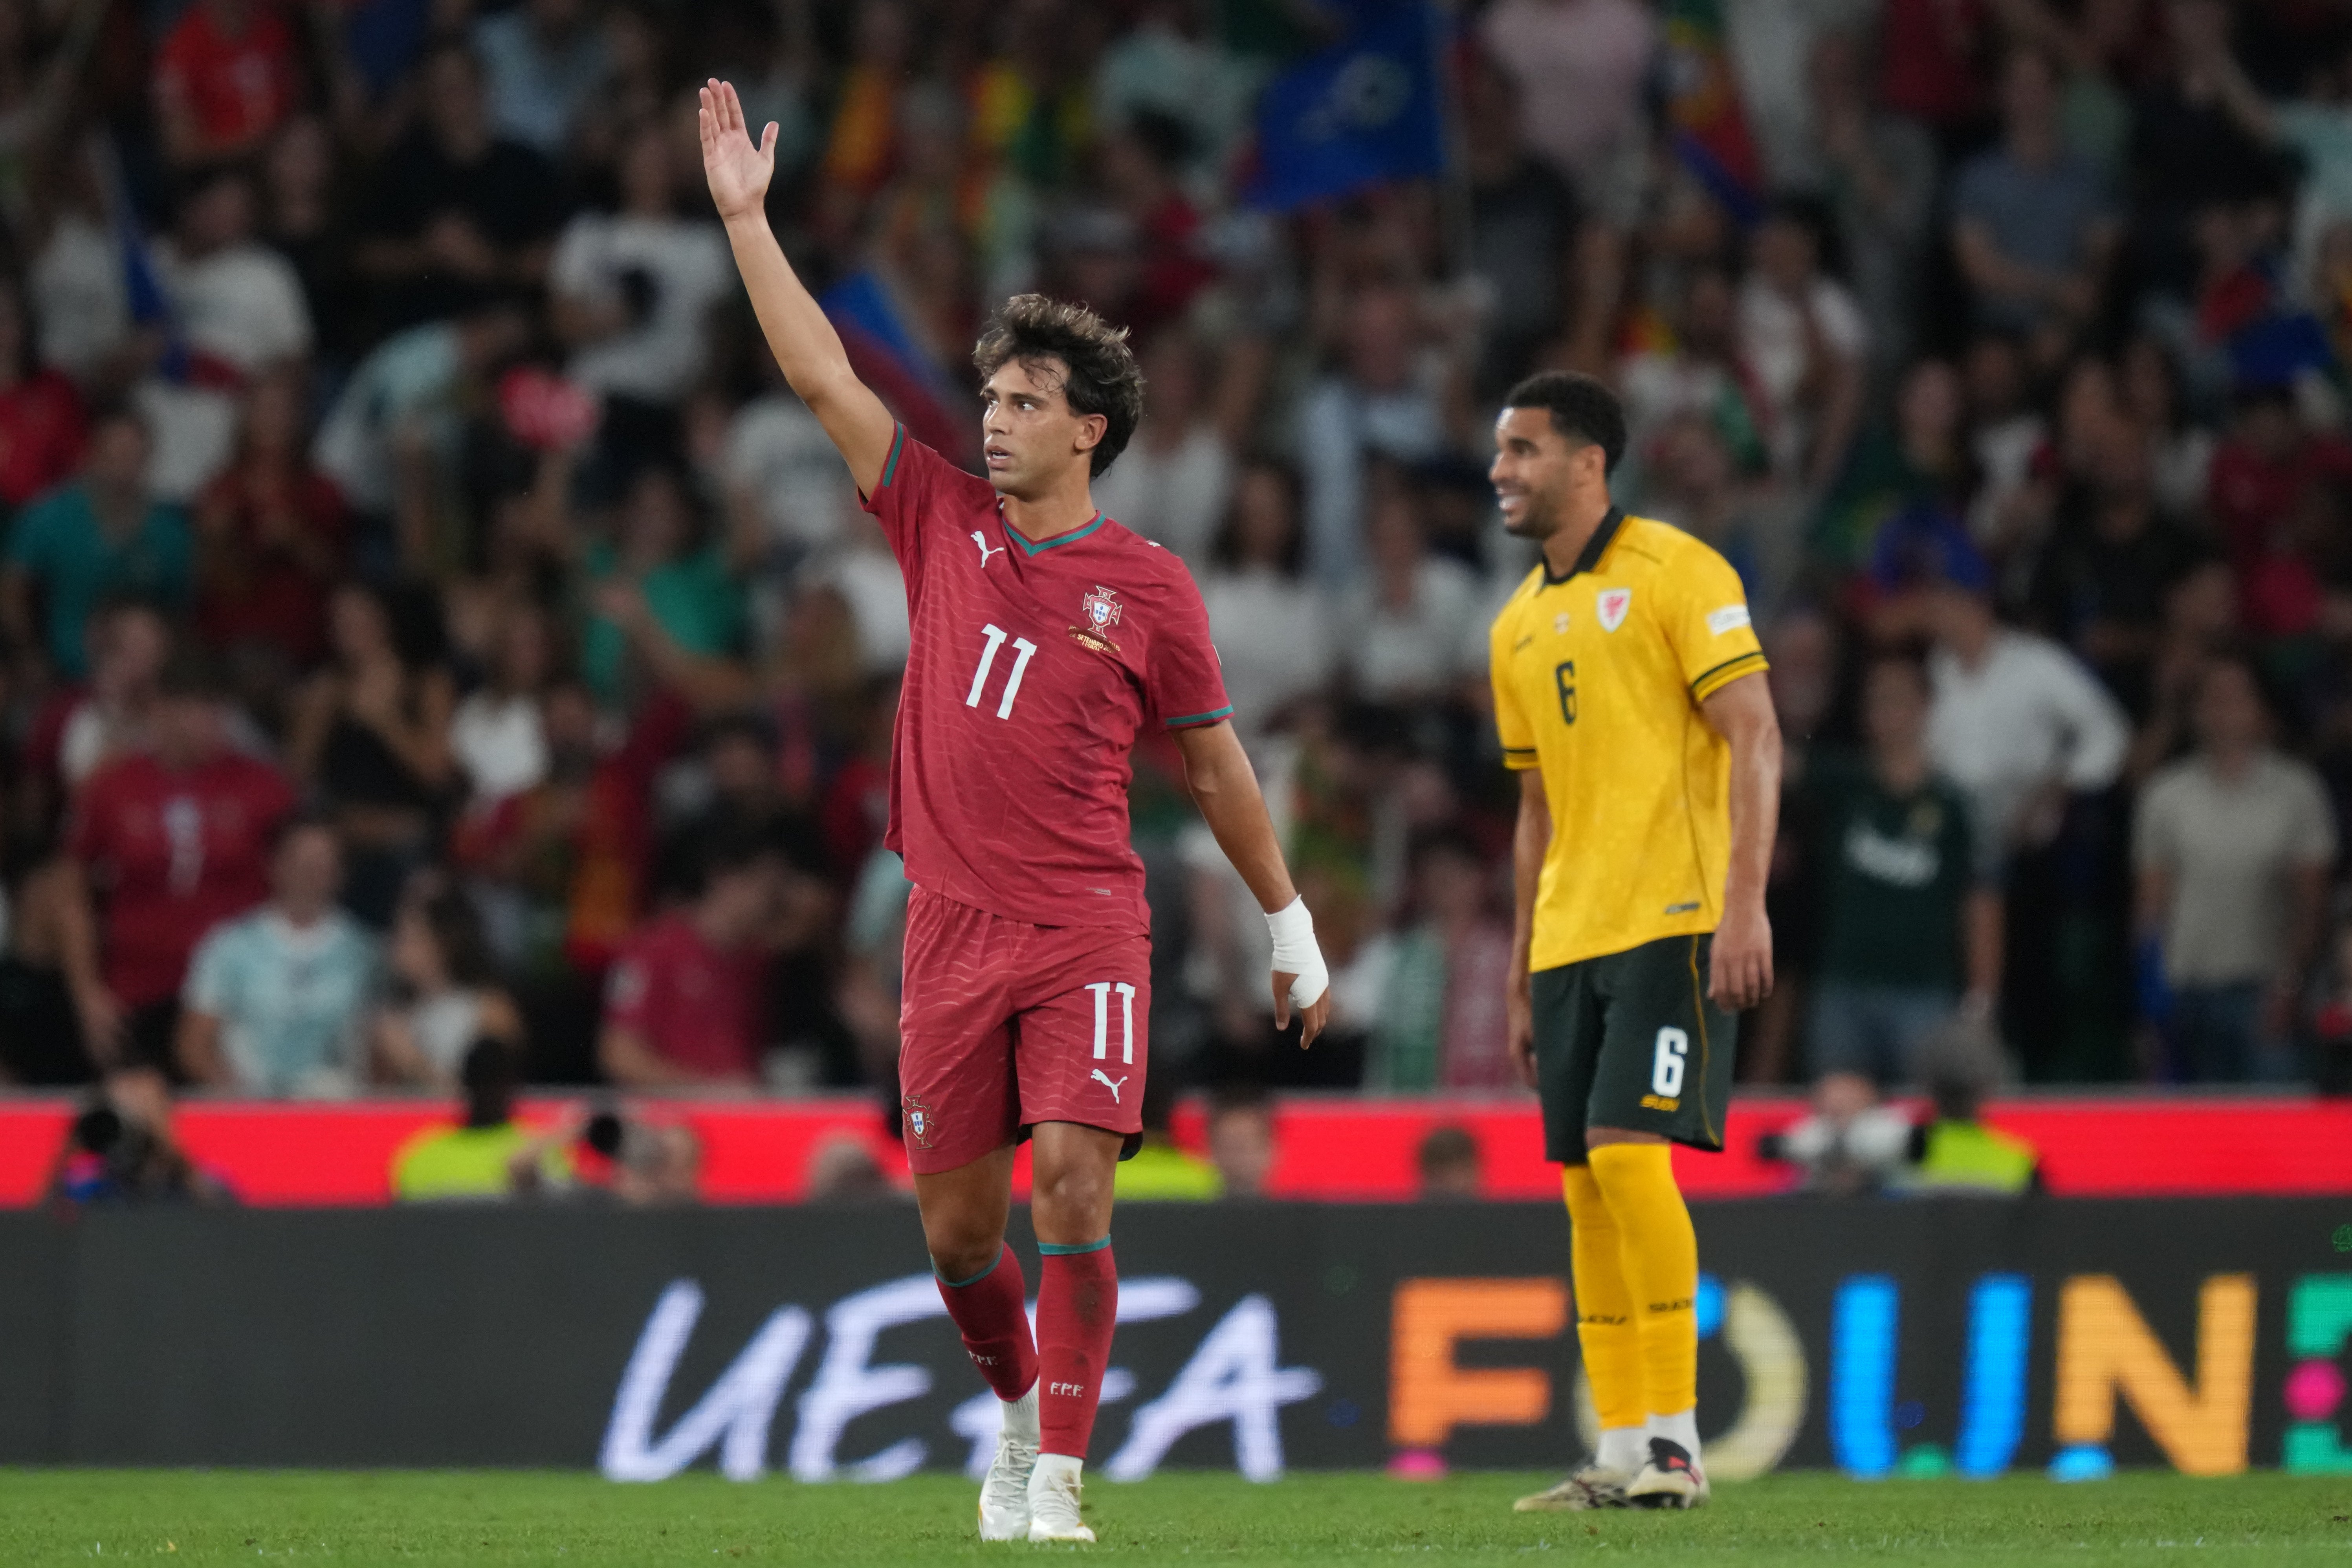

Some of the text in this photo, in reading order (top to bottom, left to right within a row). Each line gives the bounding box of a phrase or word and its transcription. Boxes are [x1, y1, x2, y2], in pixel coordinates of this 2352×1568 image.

[966, 623, 1037, 720] 11
[1077, 634, 1104, 649] SETEMBRO
[1555, 660, 1576, 726] 6
[1084, 982, 1135, 1064] 11
[1652, 1025, 1688, 1098] 6
[599, 1274, 1323, 1483] UEFA
